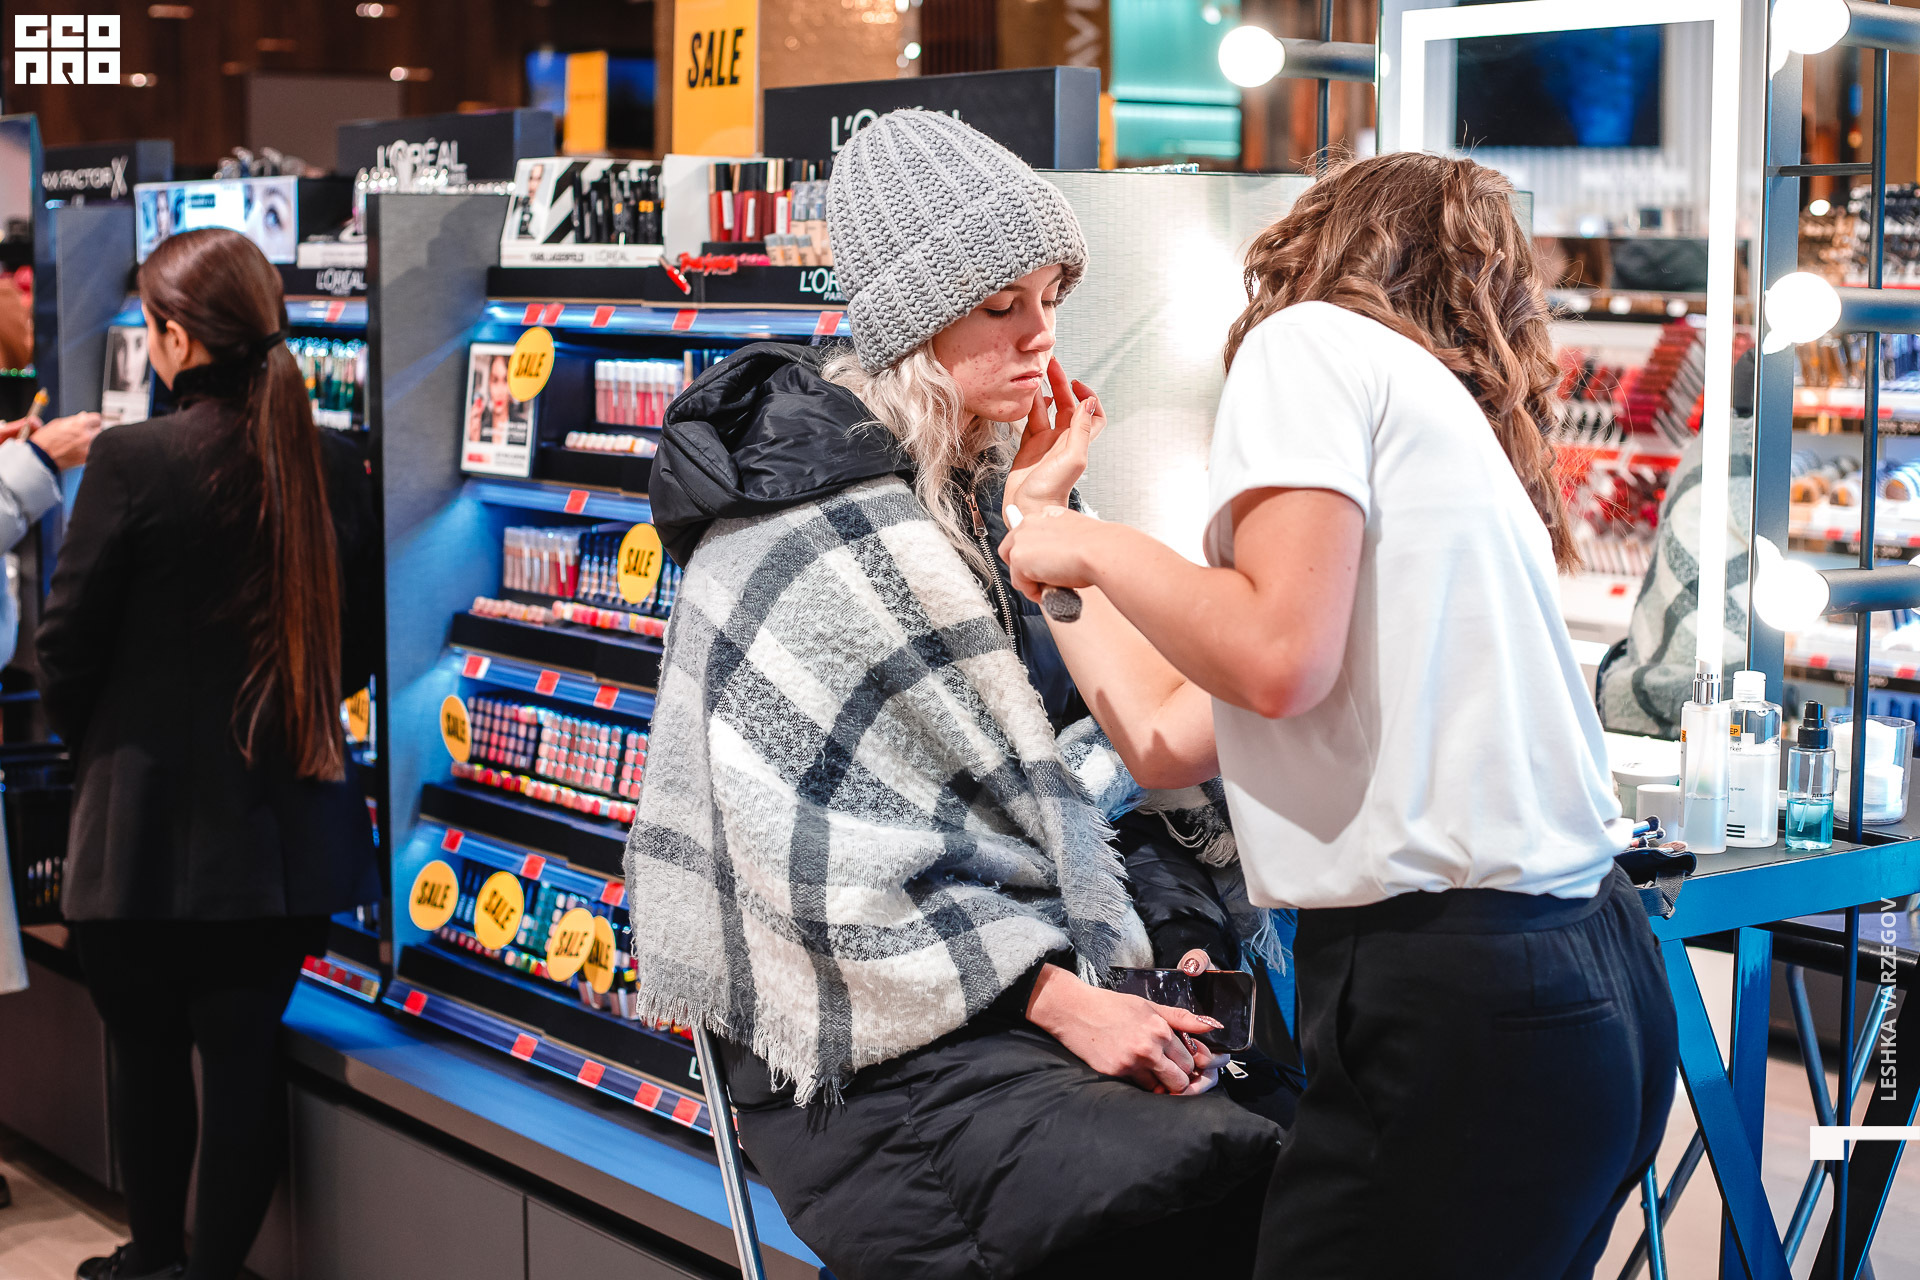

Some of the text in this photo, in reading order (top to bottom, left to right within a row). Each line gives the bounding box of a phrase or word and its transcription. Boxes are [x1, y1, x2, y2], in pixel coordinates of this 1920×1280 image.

[687, 27, 744, 88] SALE
[515, 352, 547, 378] SALE
[624, 548, 655, 578] SALE
[446, 712, 466, 744] SALE
[417, 880, 450, 909] SALE
[484, 889, 516, 930] SALE
[554, 930, 589, 957] SALE
